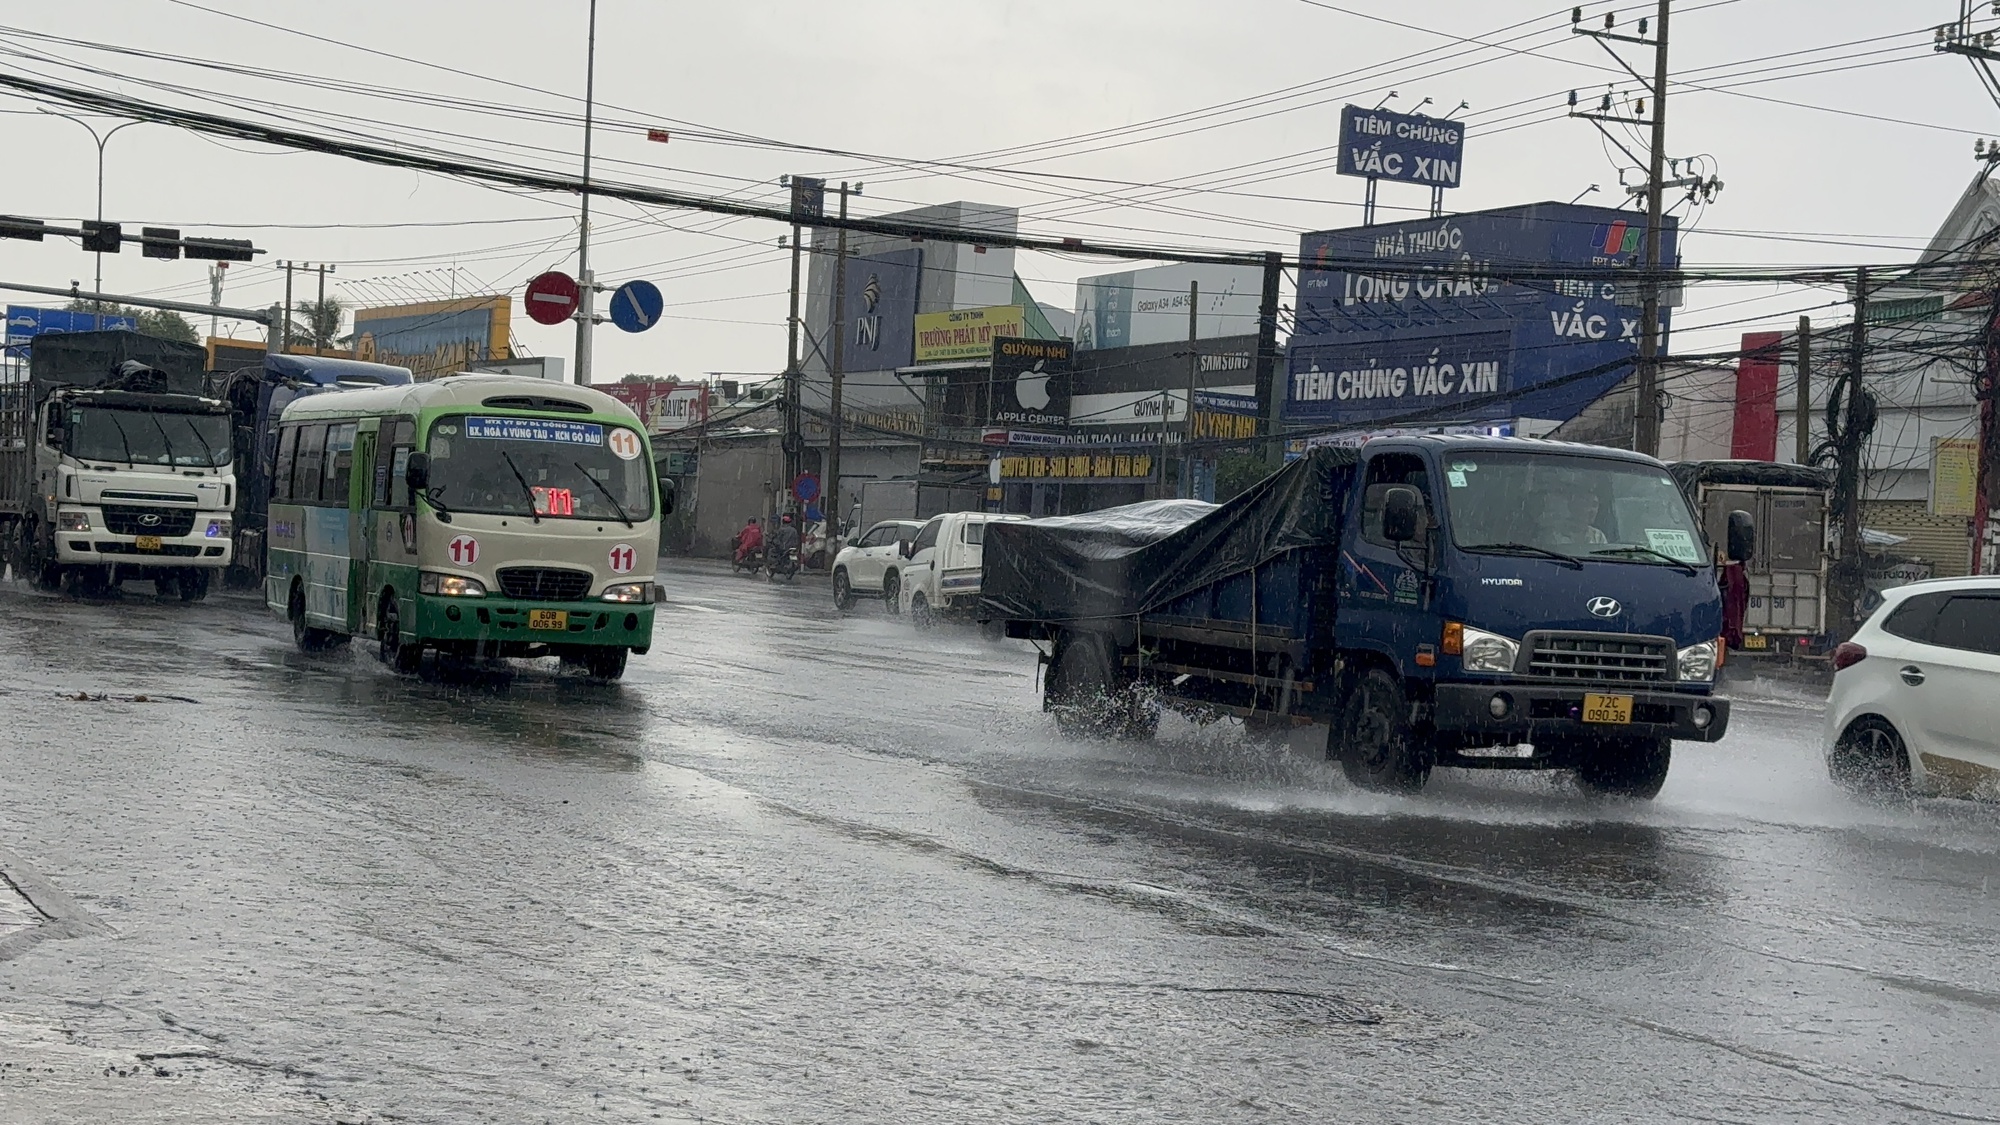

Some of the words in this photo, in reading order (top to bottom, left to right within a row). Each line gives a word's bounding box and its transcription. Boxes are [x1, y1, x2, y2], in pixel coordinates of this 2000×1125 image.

[1353, 115, 1392, 136] TIÊM
[1352, 140, 1404, 175] VẮC
[1412, 156, 1457, 183] XIN
[1374, 229, 1405, 259] NHÀ
[1408, 219, 1463, 255] THUỐC
[1592, 256, 1609, 266] FPT
[1307, 279, 1317, 289] FPT
[1344, 271, 1410, 306] LONG
[1416, 251, 1490, 299] CHÂU
[1137, 299, 1158, 313] Galaxy
[1158, 298, 1169, 310] A34
[1172, 297, 1183, 308] A54
[1551, 300, 1607, 339] VẮC
[856, 316, 878, 351] PNJ
[919, 326, 952, 348] TRƯỜNG
[953, 323, 977, 345] PHÁT
[1002, 340, 1044, 357] QUỲNH
[1047, 346, 1067, 359] NHI
[1200, 351, 1250, 372] SAMSUNG
[1295, 365, 1335, 401] TIÊM
[1337, 358, 1408, 400] CHỦNG
[1412, 347, 1456, 396] VẮC
[1458, 361, 1499, 394] XIN
[672, 397, 688, 420] VIỆT
[996, 411, 1026, 422] APPLE
[1028, 413, 1065, 425] CENTER
[502, 429, 508, 438] 4
[533, 428, 548, 440] TÀU
[555, 430, 570, 441] KCN
[572, 431, 584, 443] GÒ
[1235, 415, 1257, 439] NHI
[612, 433, 636, 454] 11
[1652, 532, 1675, 541] CÔNG
[450, 539, 475, 562] 11
[610, 547, 633, 570] 11
[1481, 577, 1523, 587] HYUNDAI
[1773, 597, 1785, 609] 50
[540, 610, 557, 620] 60B
[1599, 696, 1619, 708] 72C
[1588, 709, 1626, 722] 090.36
